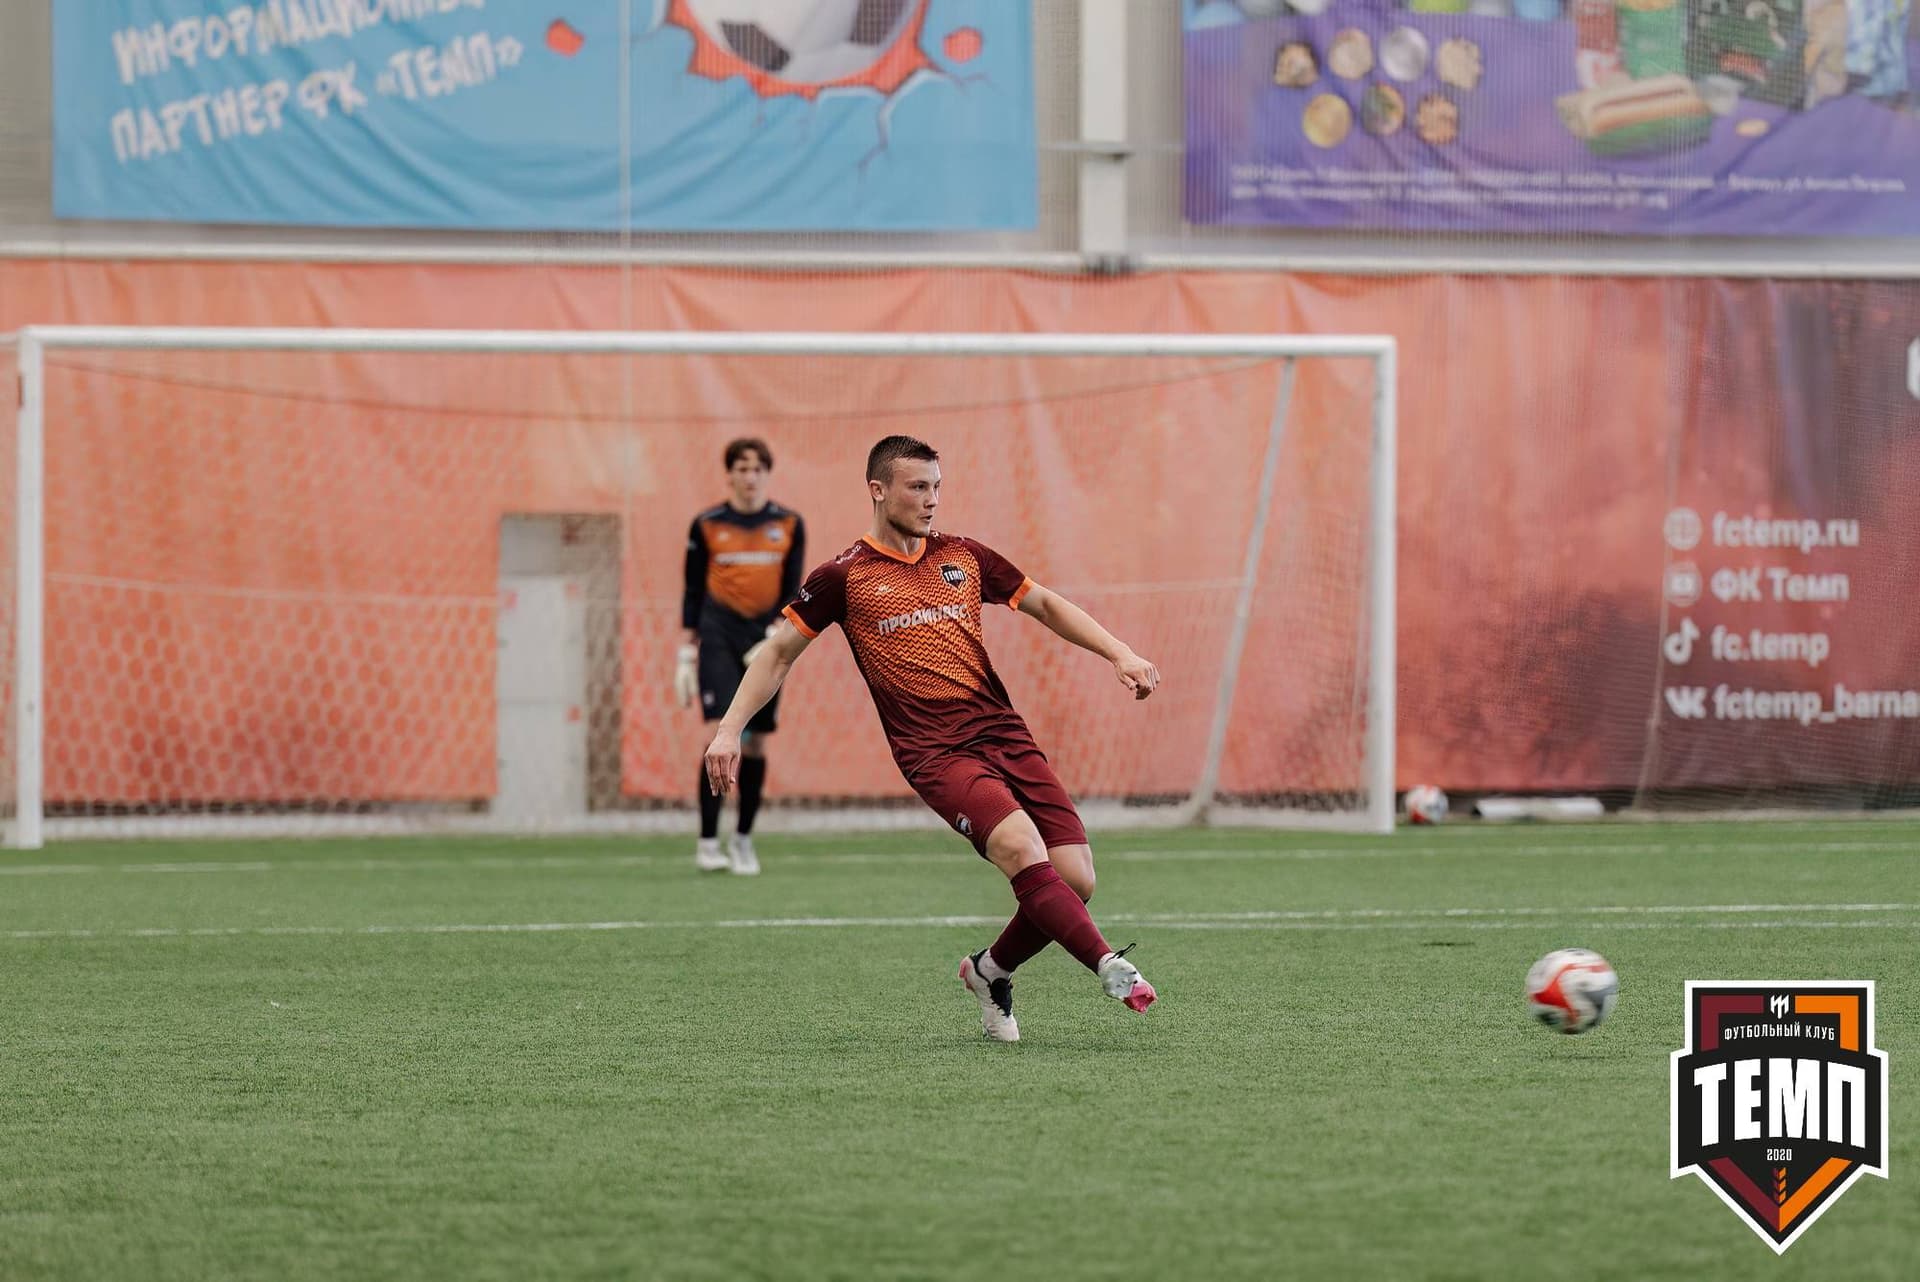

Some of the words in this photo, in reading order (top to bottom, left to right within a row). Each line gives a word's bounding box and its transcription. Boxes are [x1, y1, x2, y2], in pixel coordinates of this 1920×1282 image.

[111, 79, 289, 163] ПАРТНЕР
[298, 64, 367, 119] ФК
[1712, 511, 1860, 554] fctemp.ru
[1710, 567, 1762, 602] ФК
[1765, 567, 1850, 602] Темп
[878, 603, 971, 636] ПРОДИНВЕС
[1711, 624, 1830, 668] fc.temp
